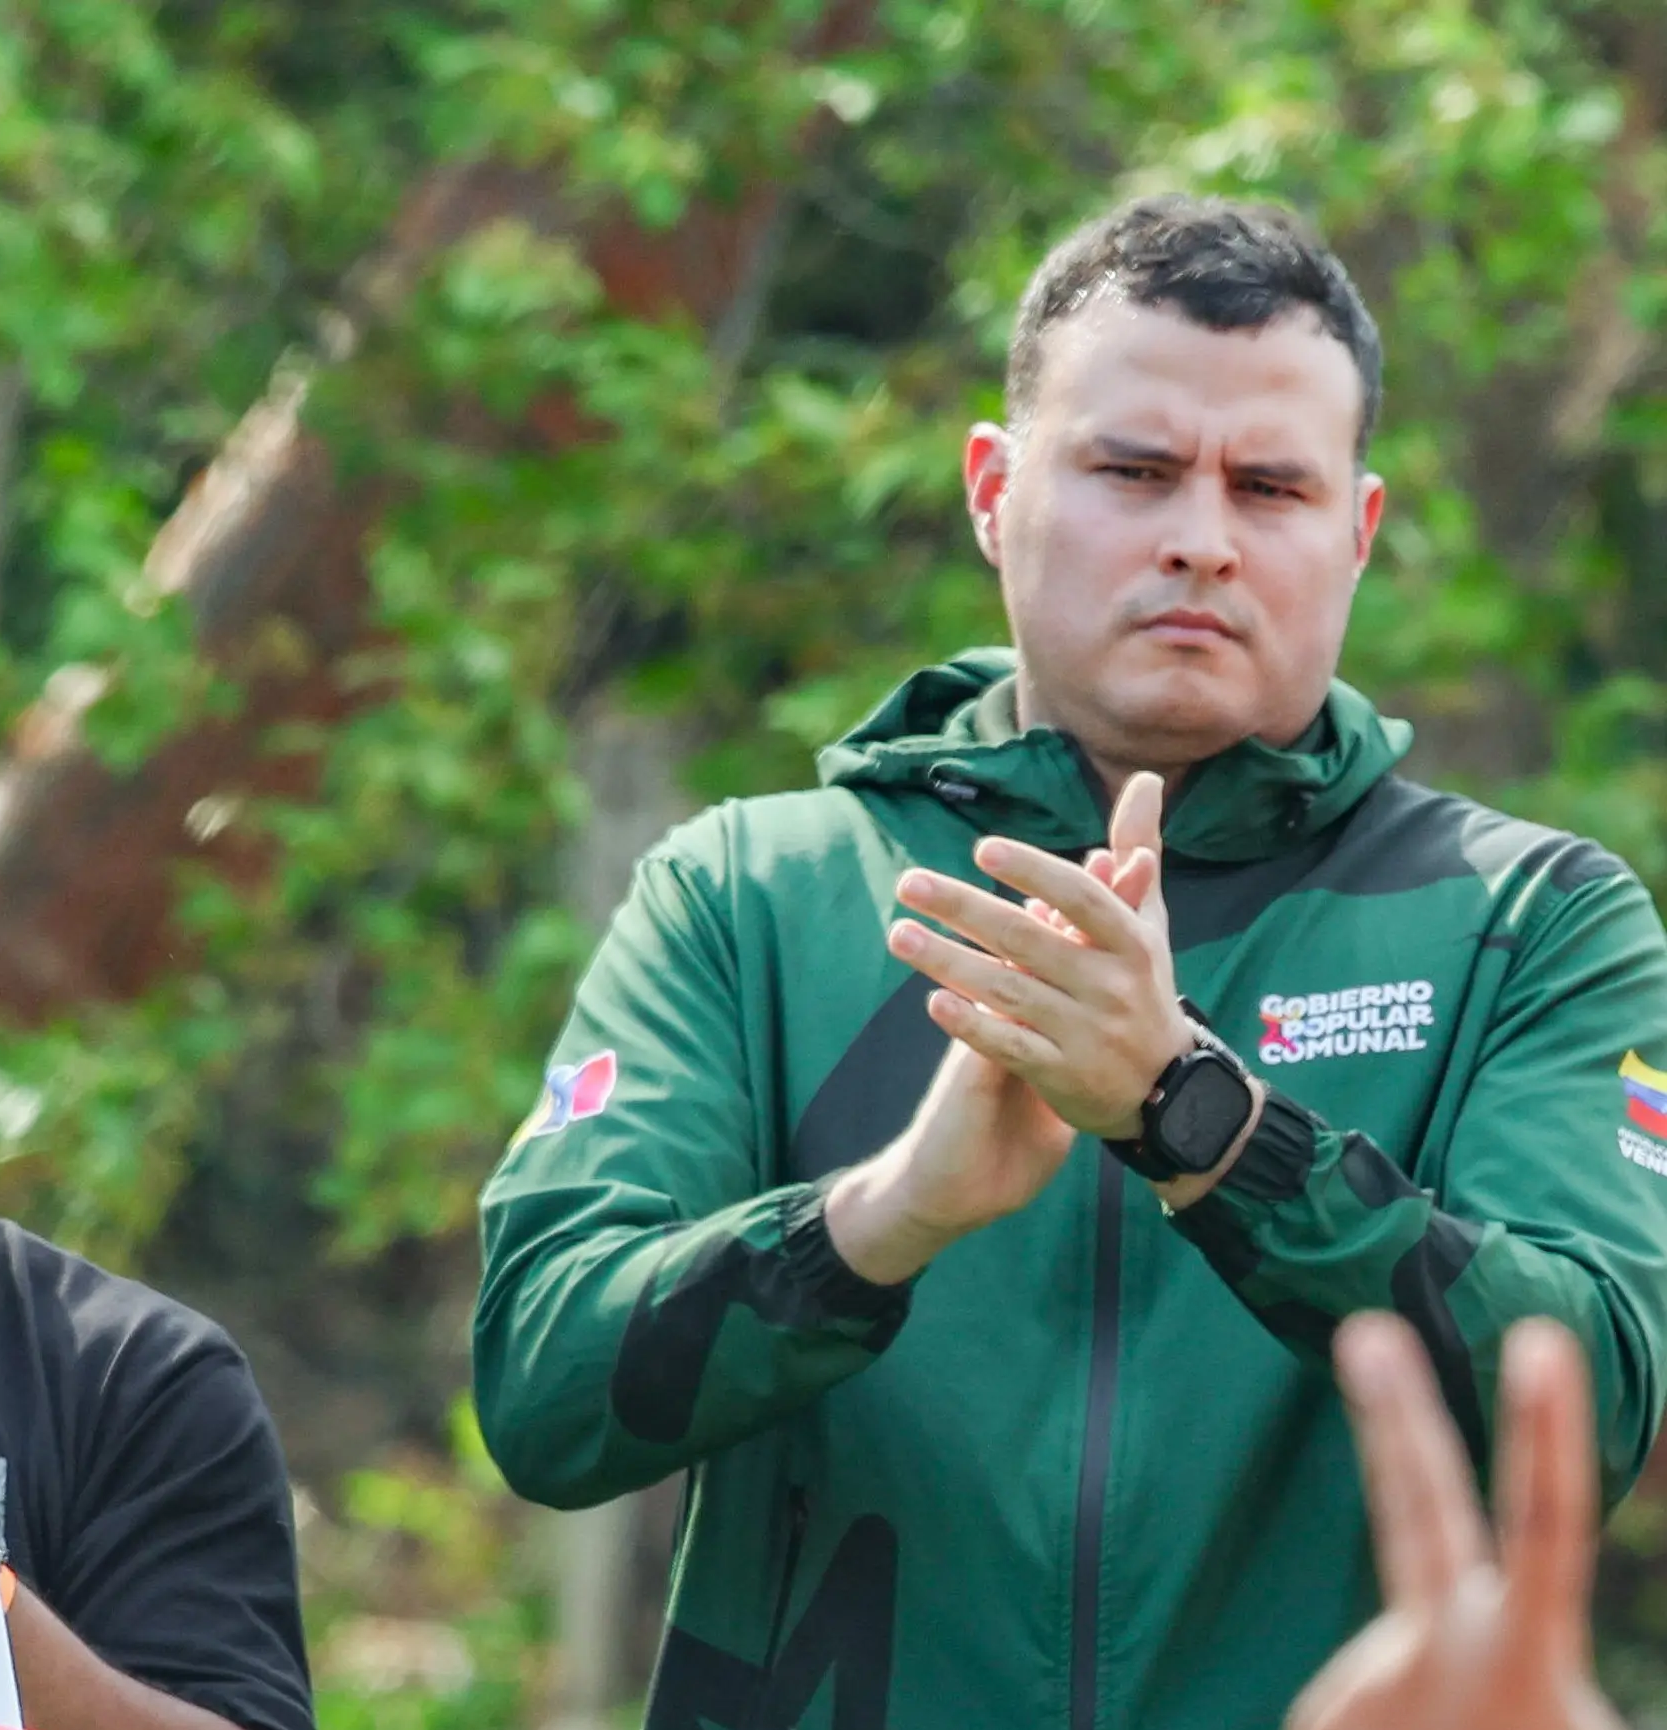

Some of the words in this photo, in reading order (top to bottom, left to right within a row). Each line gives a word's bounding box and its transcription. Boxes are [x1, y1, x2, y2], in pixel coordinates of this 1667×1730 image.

[1259, 980, 1434, 1018] GOBIERNO
[1280, 1003, 1434, 1039] POPULAR
[1259, 1028, 1427, 1064] COMUNAL
